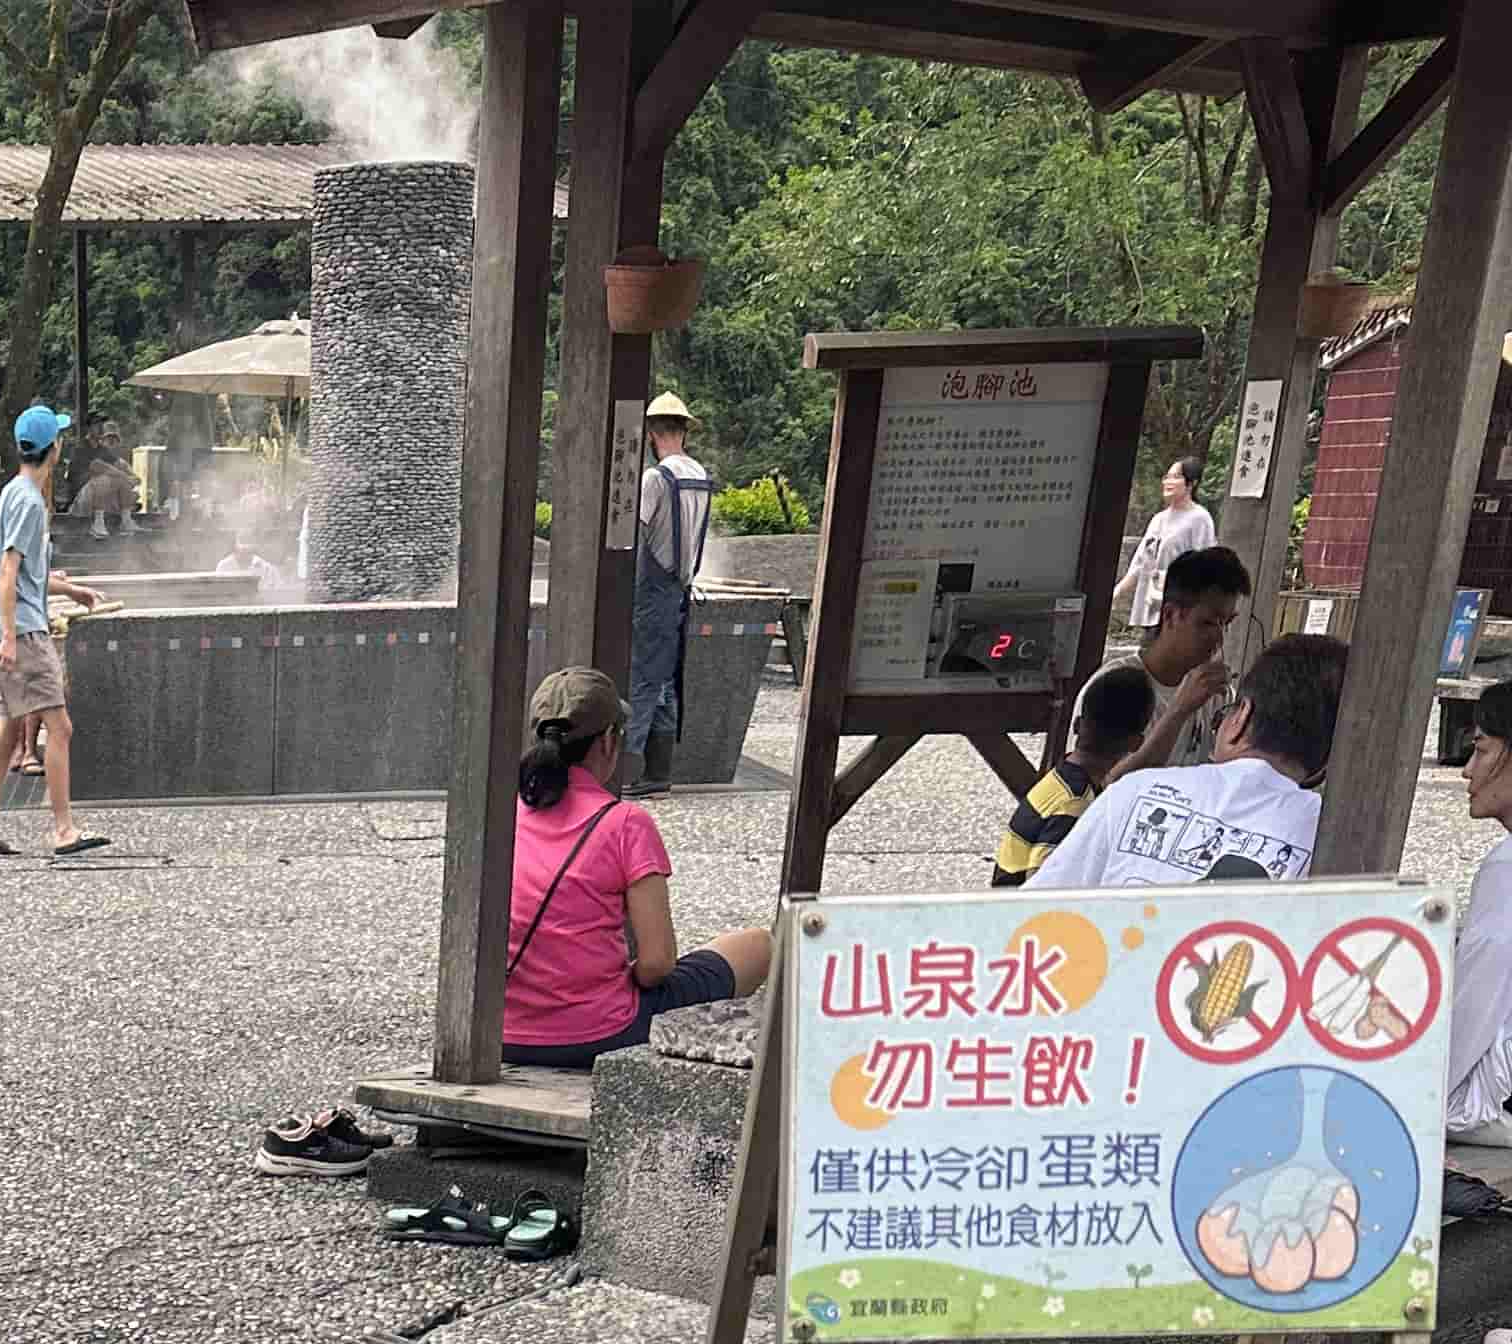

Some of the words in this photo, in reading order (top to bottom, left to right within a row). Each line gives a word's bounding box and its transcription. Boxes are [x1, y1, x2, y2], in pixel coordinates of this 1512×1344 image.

[940, 366, 1039, 401] 泡腳池
[820, 938, 1065, 1019] 山泉水
[865, 1034, 1147, 1111] 勿生飲！
[809, 1131, 1163, 1195] 僅供冷卻蛋類
[804, 1200, 1165, 1253] 不建議其他食材放入
[848, 1296, 949, 1319] 宜蘭縣政府
